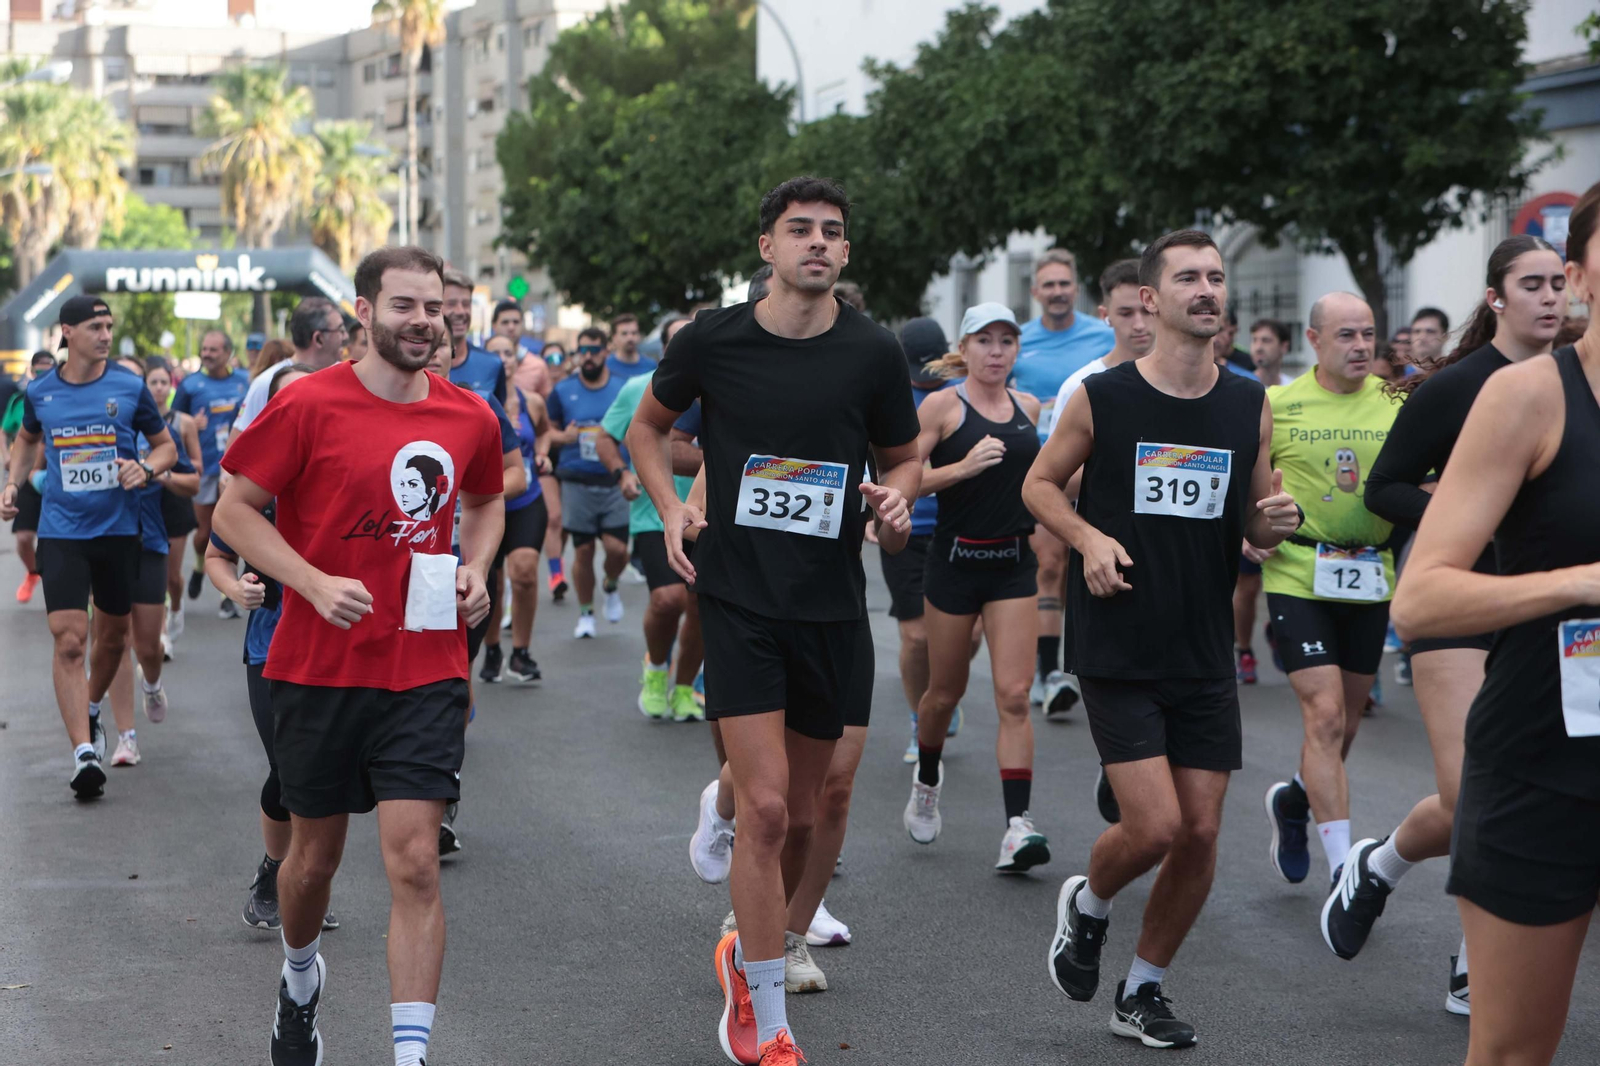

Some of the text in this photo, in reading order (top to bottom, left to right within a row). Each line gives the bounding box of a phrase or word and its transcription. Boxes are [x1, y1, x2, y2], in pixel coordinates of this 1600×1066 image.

[51, 424, 117, 437] POLICIA
[1144, 450, 1224, 464] CARRERA POPULAR
[753, 461, 839, 479] CARRERA POPULAR
[1184, 462, 1205, 470] SANTO
[69, 468, 103, 485] 206
[795, 475, 818, 484] SANTO
[1145, 476, 1201, 507] 319
[748, 487, 813, 523] 332
[957, 547, 1017, 559] WONG
[1333, 568, 1361, 590] 12
